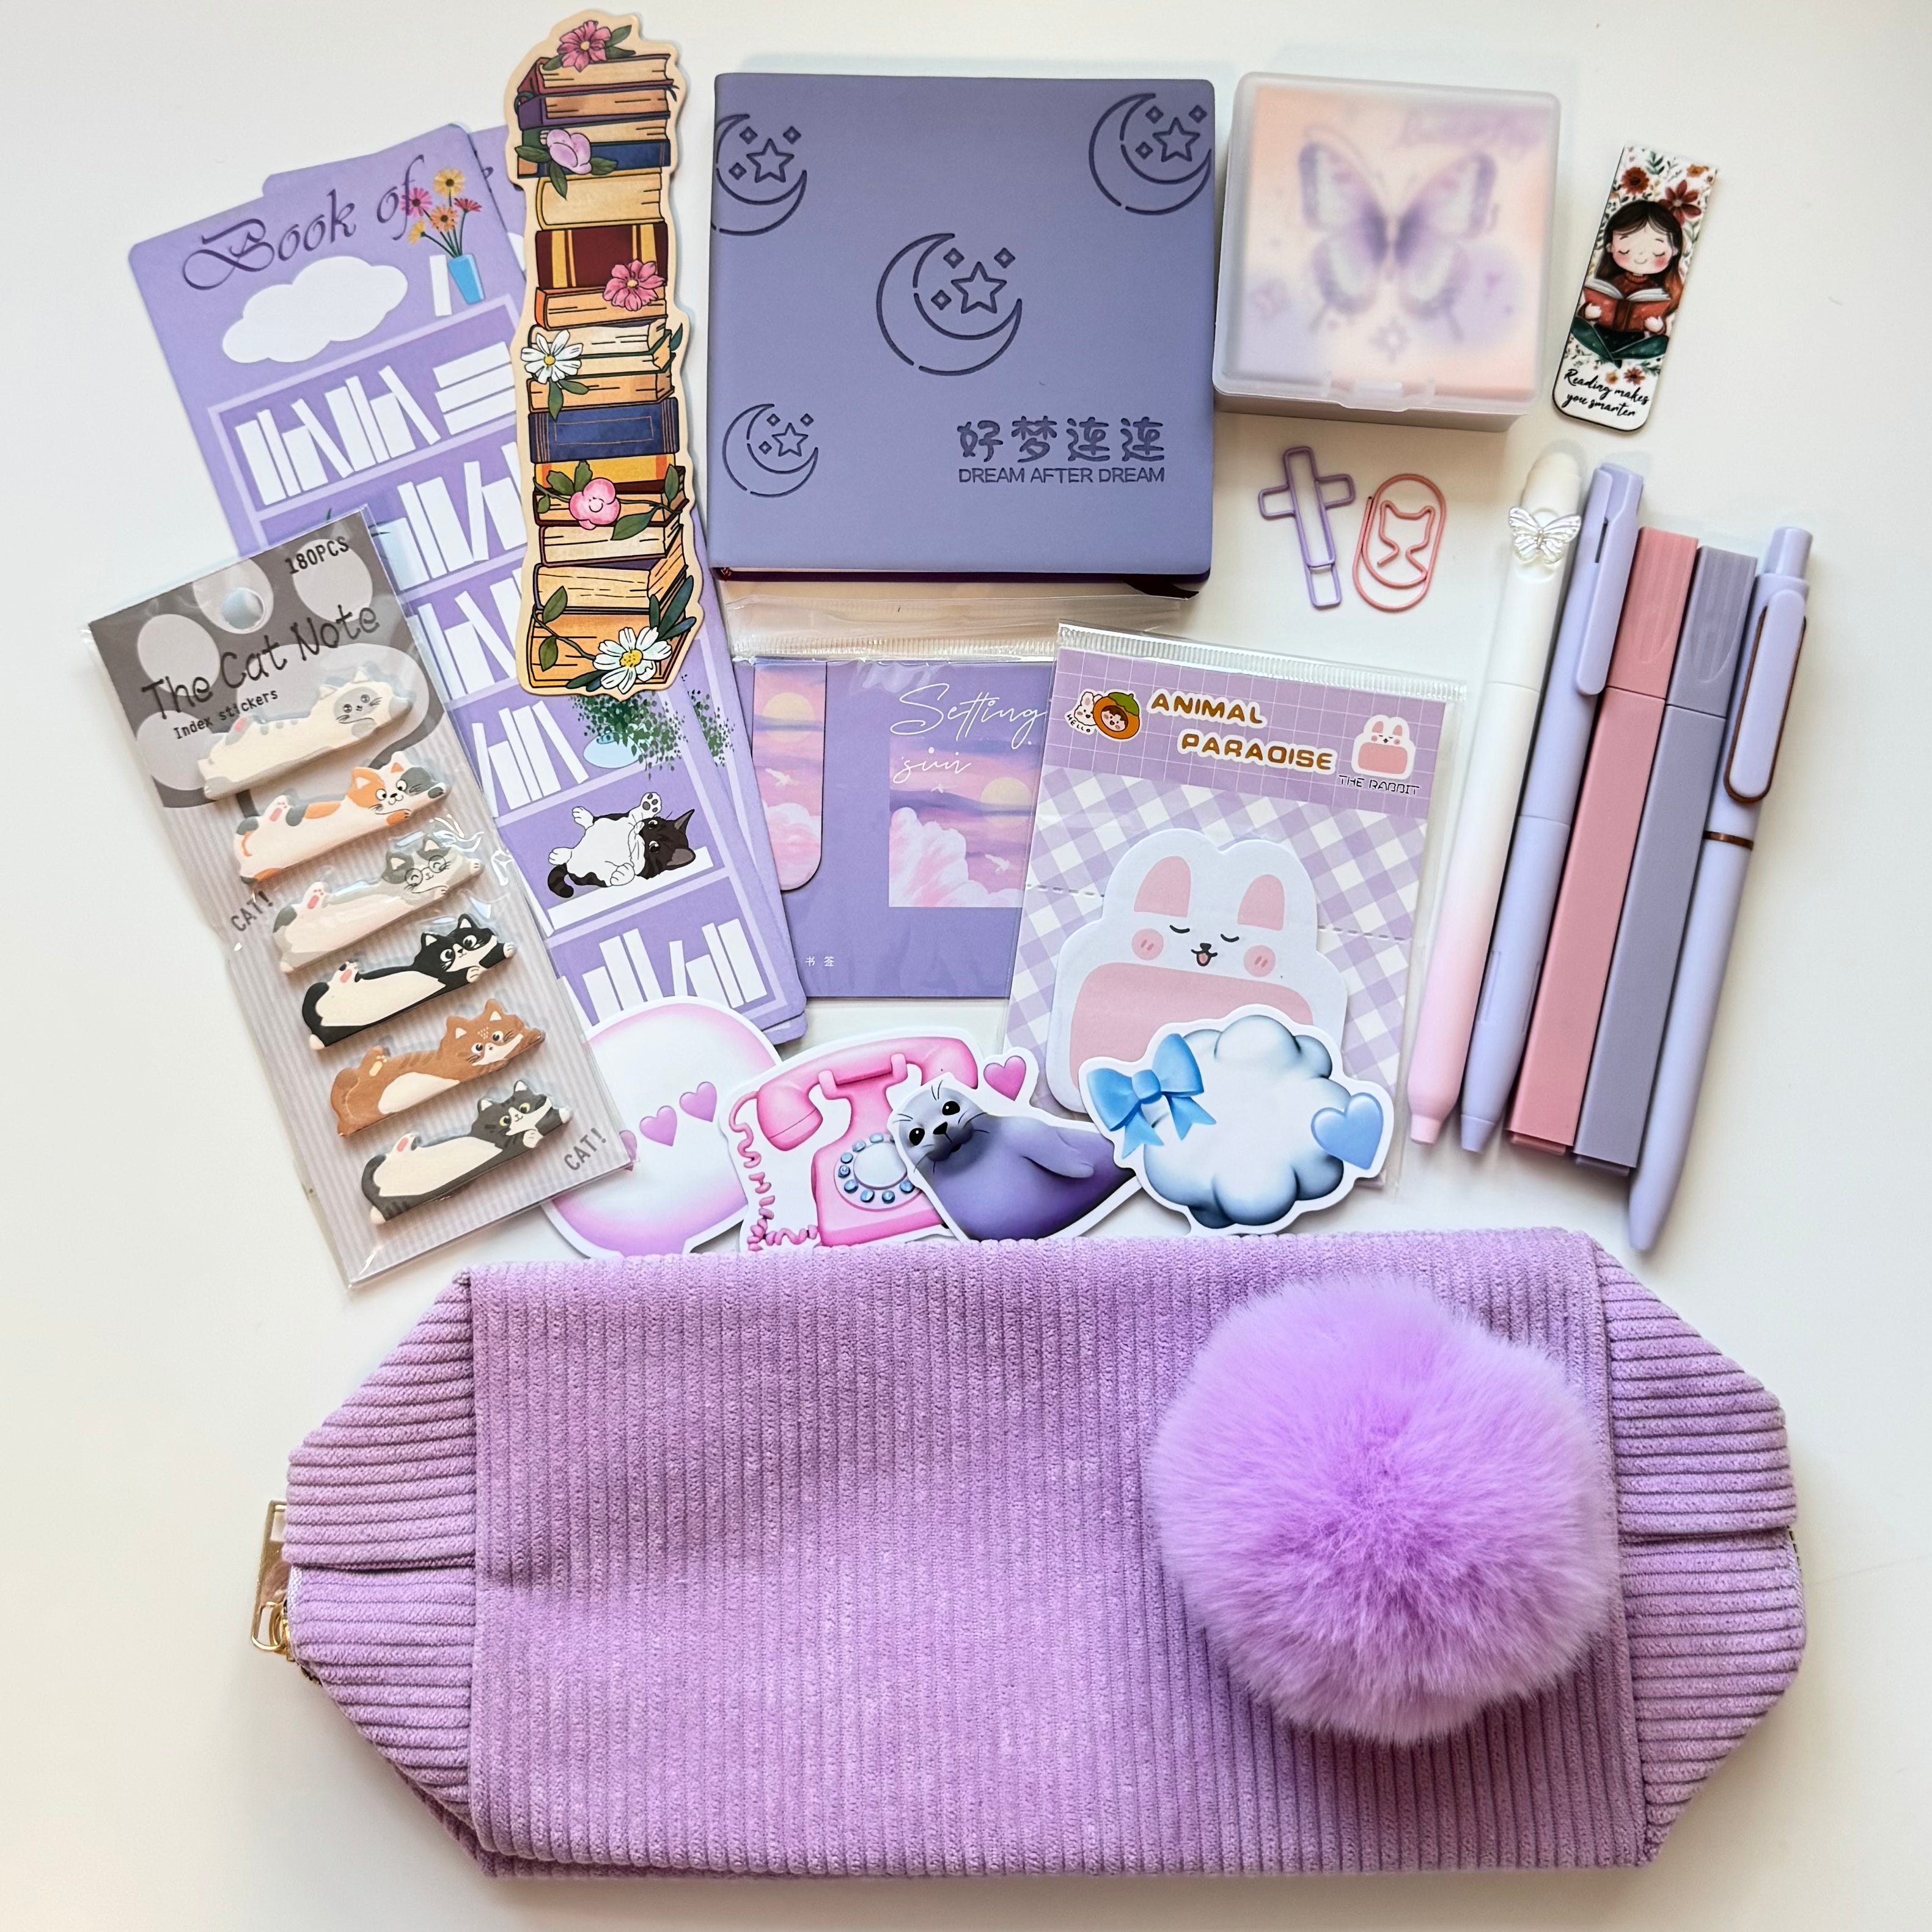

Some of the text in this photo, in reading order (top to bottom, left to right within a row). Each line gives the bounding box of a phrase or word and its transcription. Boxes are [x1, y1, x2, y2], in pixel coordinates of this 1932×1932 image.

[183, 188, 356, 291] Book
[375, 154, 425, 241] of
[1561, 393, 1636, 417] you smarter
[1564, 369, 1650, 406] Reading makes
[957, 415, 1165, 463] 好梦连连
[958, 467, 1165, 484] DREAM AFTER DREAM
[285, 535, 350, 575] 180PCS
[141, 604, 380, 720] The Cat Note
[173, 688, 279, 740] Index stickers
[890, 683, 1048, 749] Setting
[1150, 692, 1263, 725] ANIMAL
[1339, 775, 1420, 795] THE RABBIT
[231, 891, 273, 931] CAT!
[564, 1128, 606, 1170] CAT!
